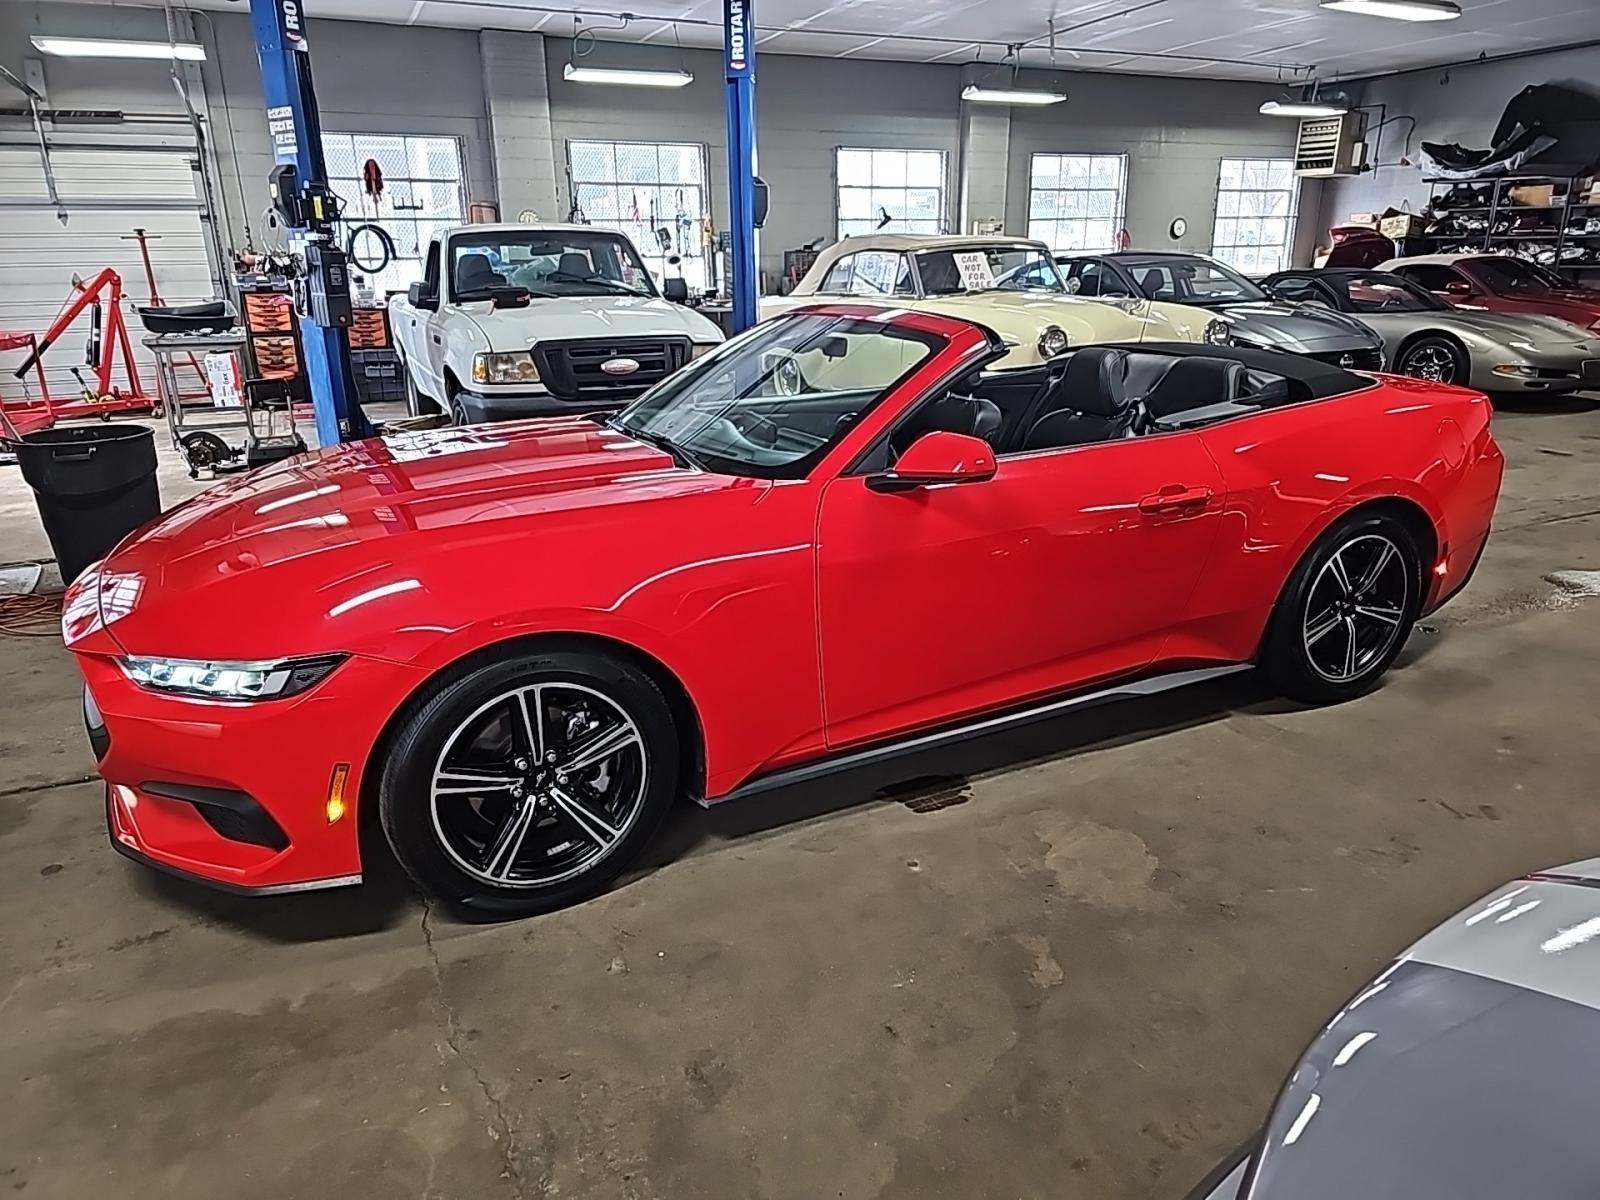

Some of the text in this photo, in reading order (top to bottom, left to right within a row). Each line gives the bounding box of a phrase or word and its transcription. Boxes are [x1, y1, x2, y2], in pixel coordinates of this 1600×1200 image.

[730, 0, 745, 60] ROTAR
[961, 255, 978, 263] CAR
[964, 263, 981, 272] NOT
[968, 272, 986, 281] FOR
[969, 280, 992, 289] SALE
